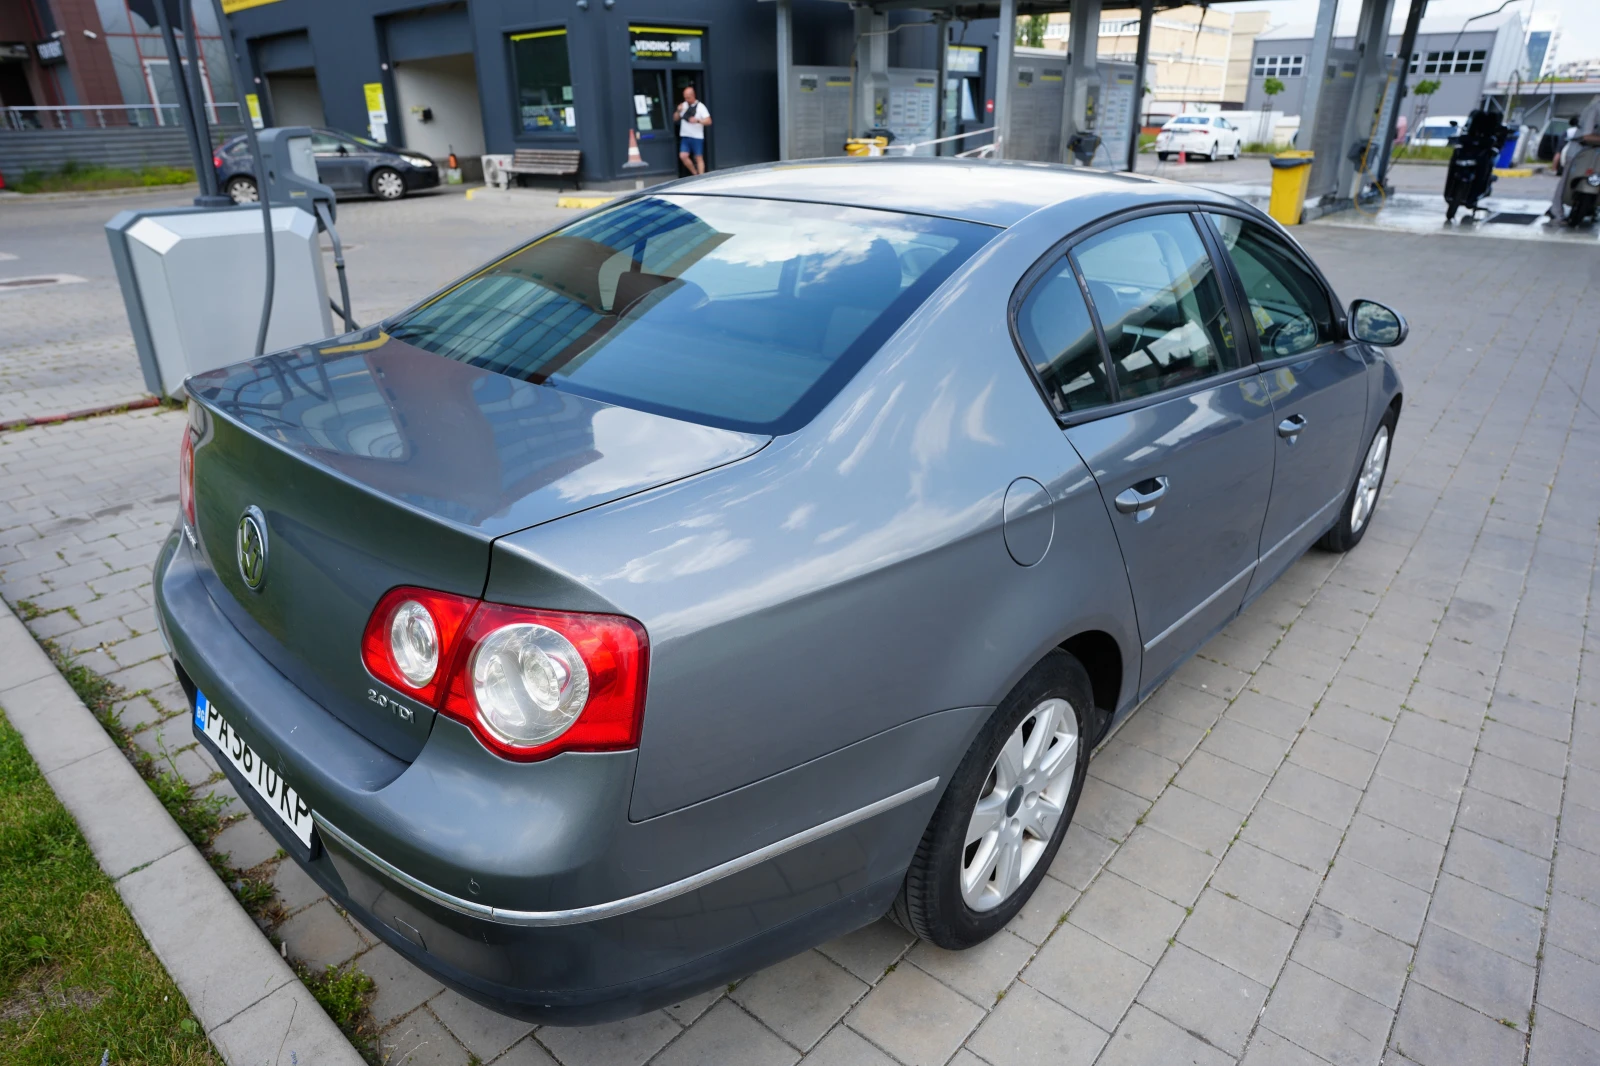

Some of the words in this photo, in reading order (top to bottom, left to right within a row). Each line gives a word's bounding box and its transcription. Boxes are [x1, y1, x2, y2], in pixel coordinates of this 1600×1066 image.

[634, 40, 670, 51] VENDING
[671, 41, 691, 52] SPOT
[196, 705, 205, 722] BG
[368, 688, 388, 708] 2.0
[389, 699, 415, 724] TDI
